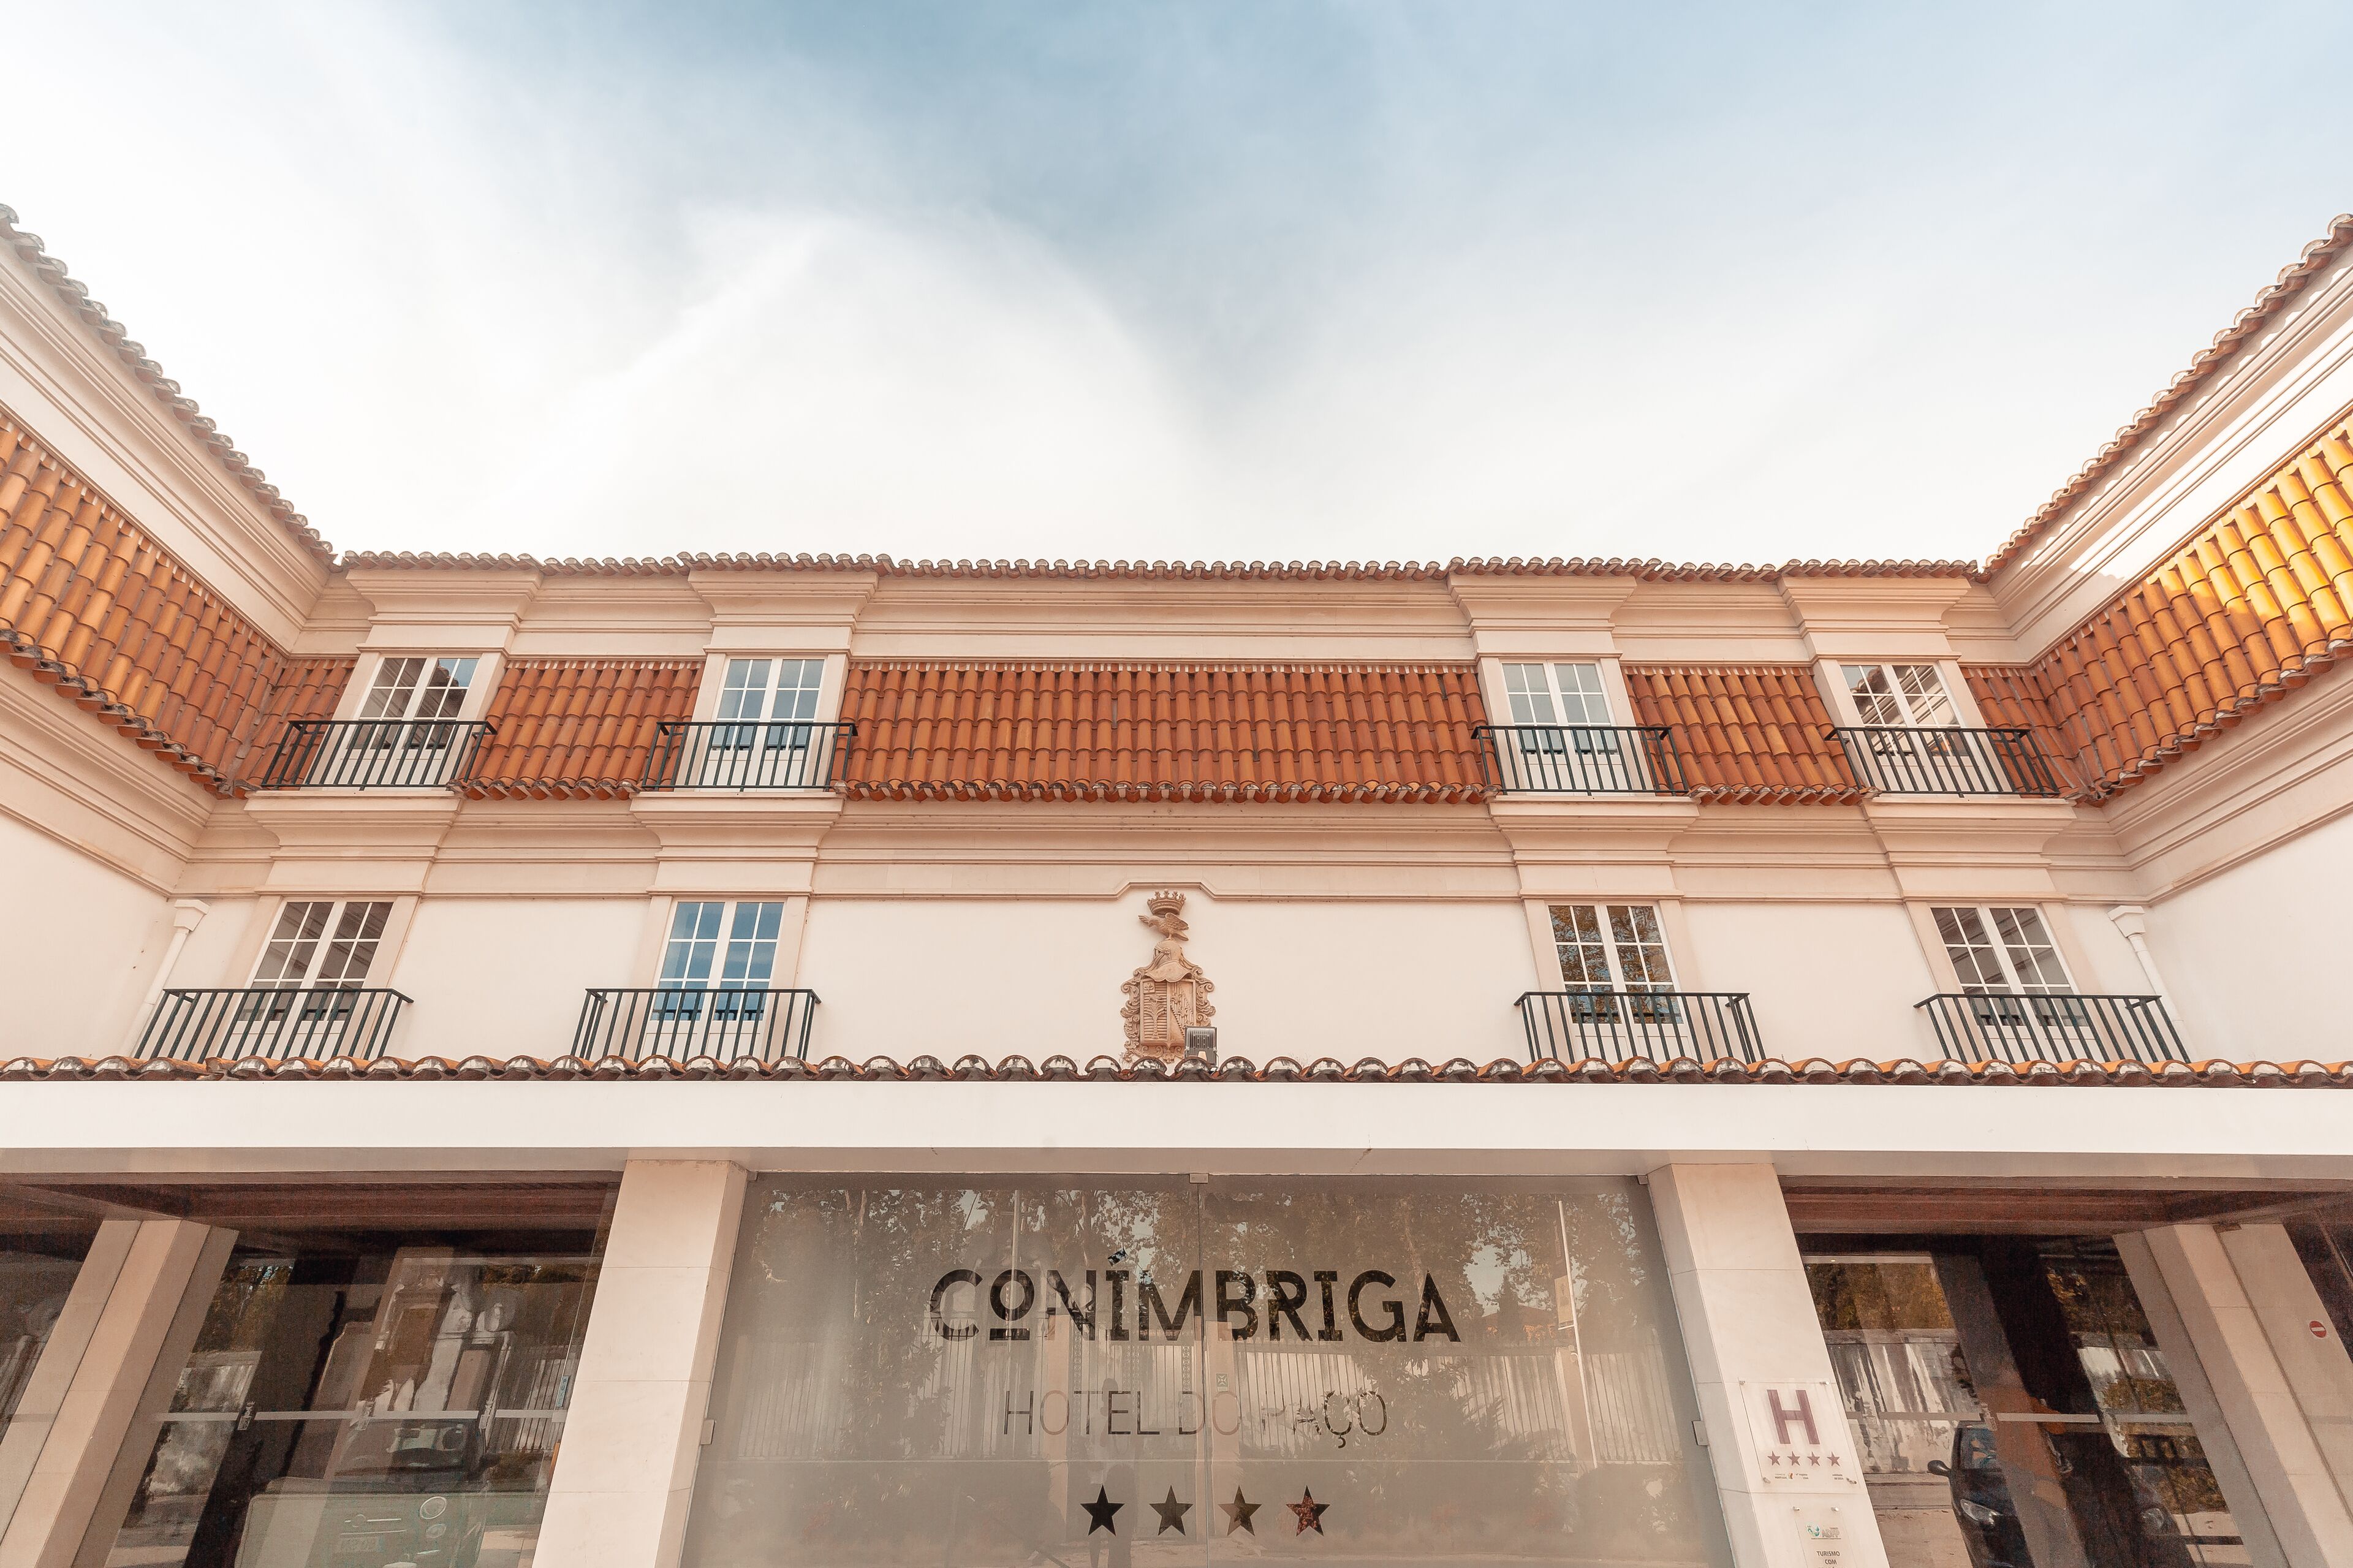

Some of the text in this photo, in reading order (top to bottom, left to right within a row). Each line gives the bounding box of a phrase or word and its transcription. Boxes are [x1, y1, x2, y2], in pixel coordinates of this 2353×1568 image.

[1003, 1390, 1161, 1436] HOTEL
[1178, 1390, 1241, 1436] DO
[1767, 1389, 1821, 1444] H
